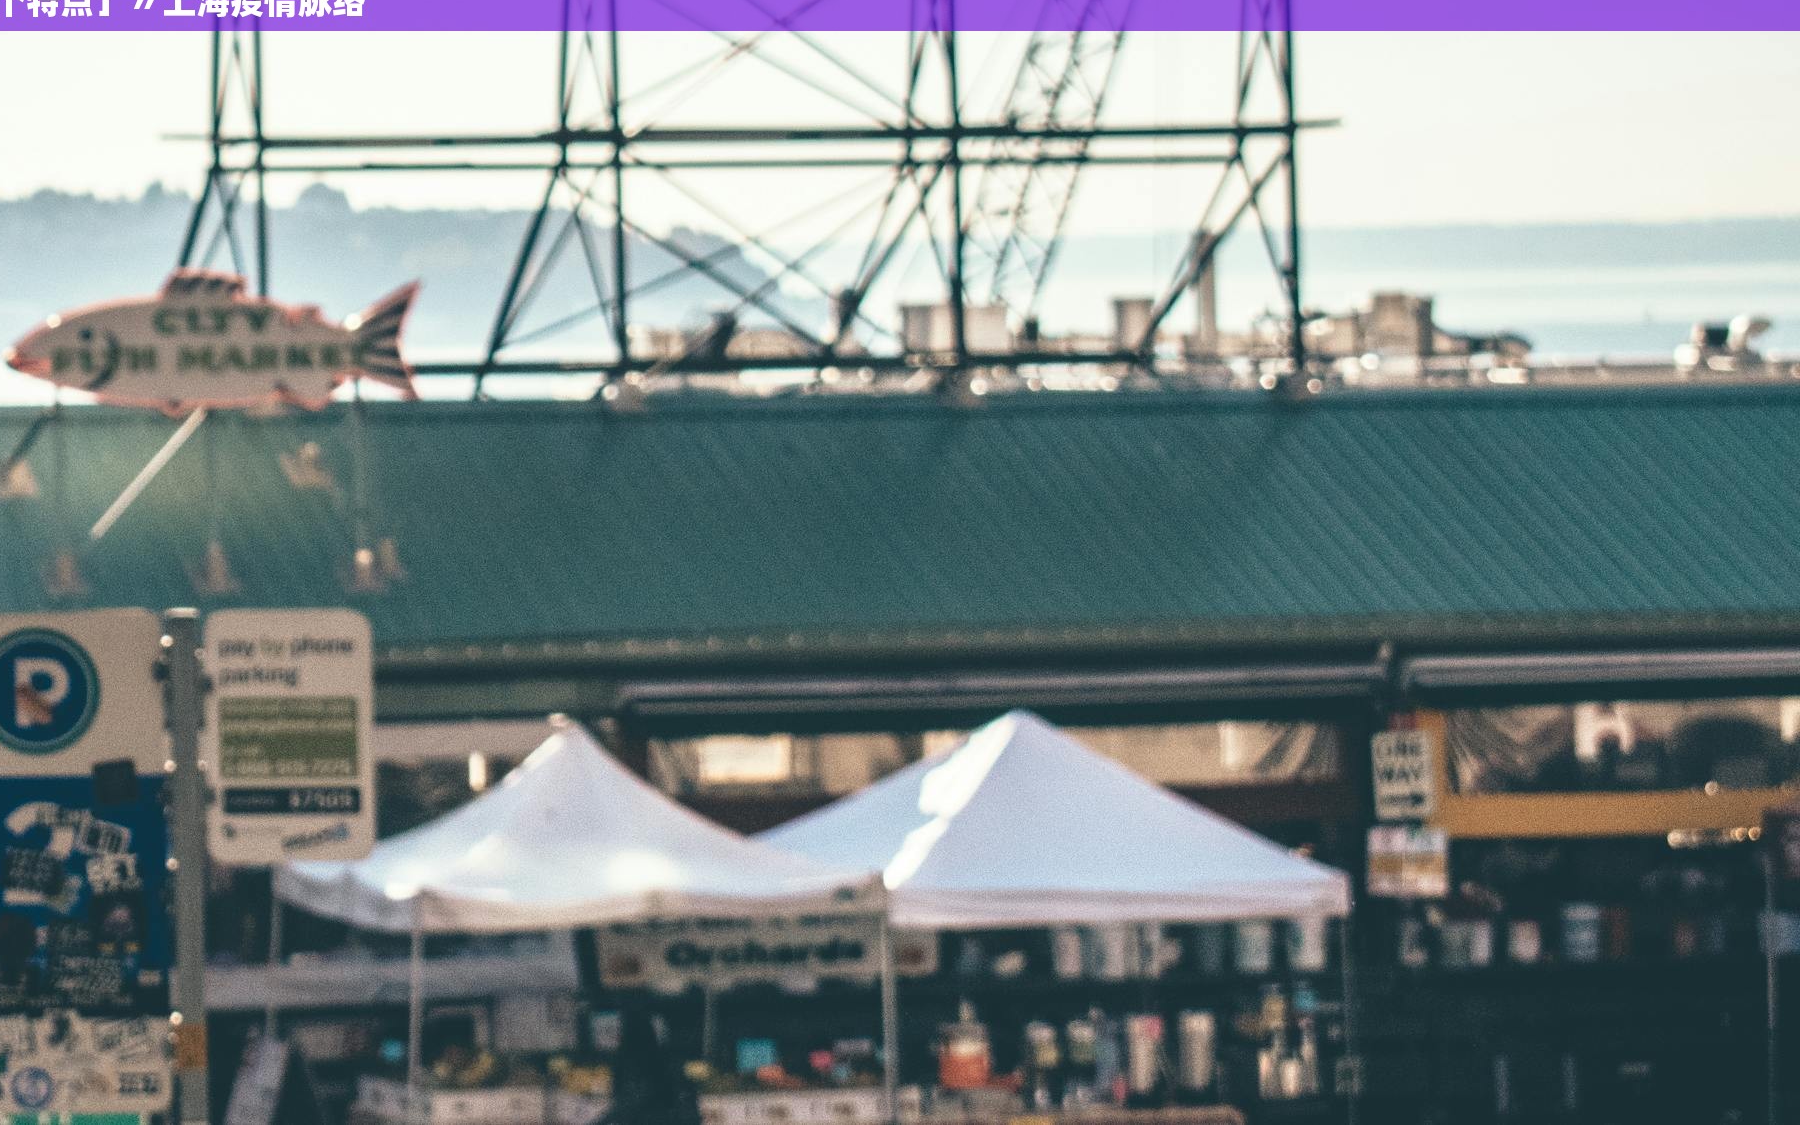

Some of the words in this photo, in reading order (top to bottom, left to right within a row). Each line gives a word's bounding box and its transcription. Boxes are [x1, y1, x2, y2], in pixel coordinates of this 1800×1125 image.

[218, 638, 255, 658] pay
[289, 634, 353, 658] phone
[218, 664, 298, 687] parking
